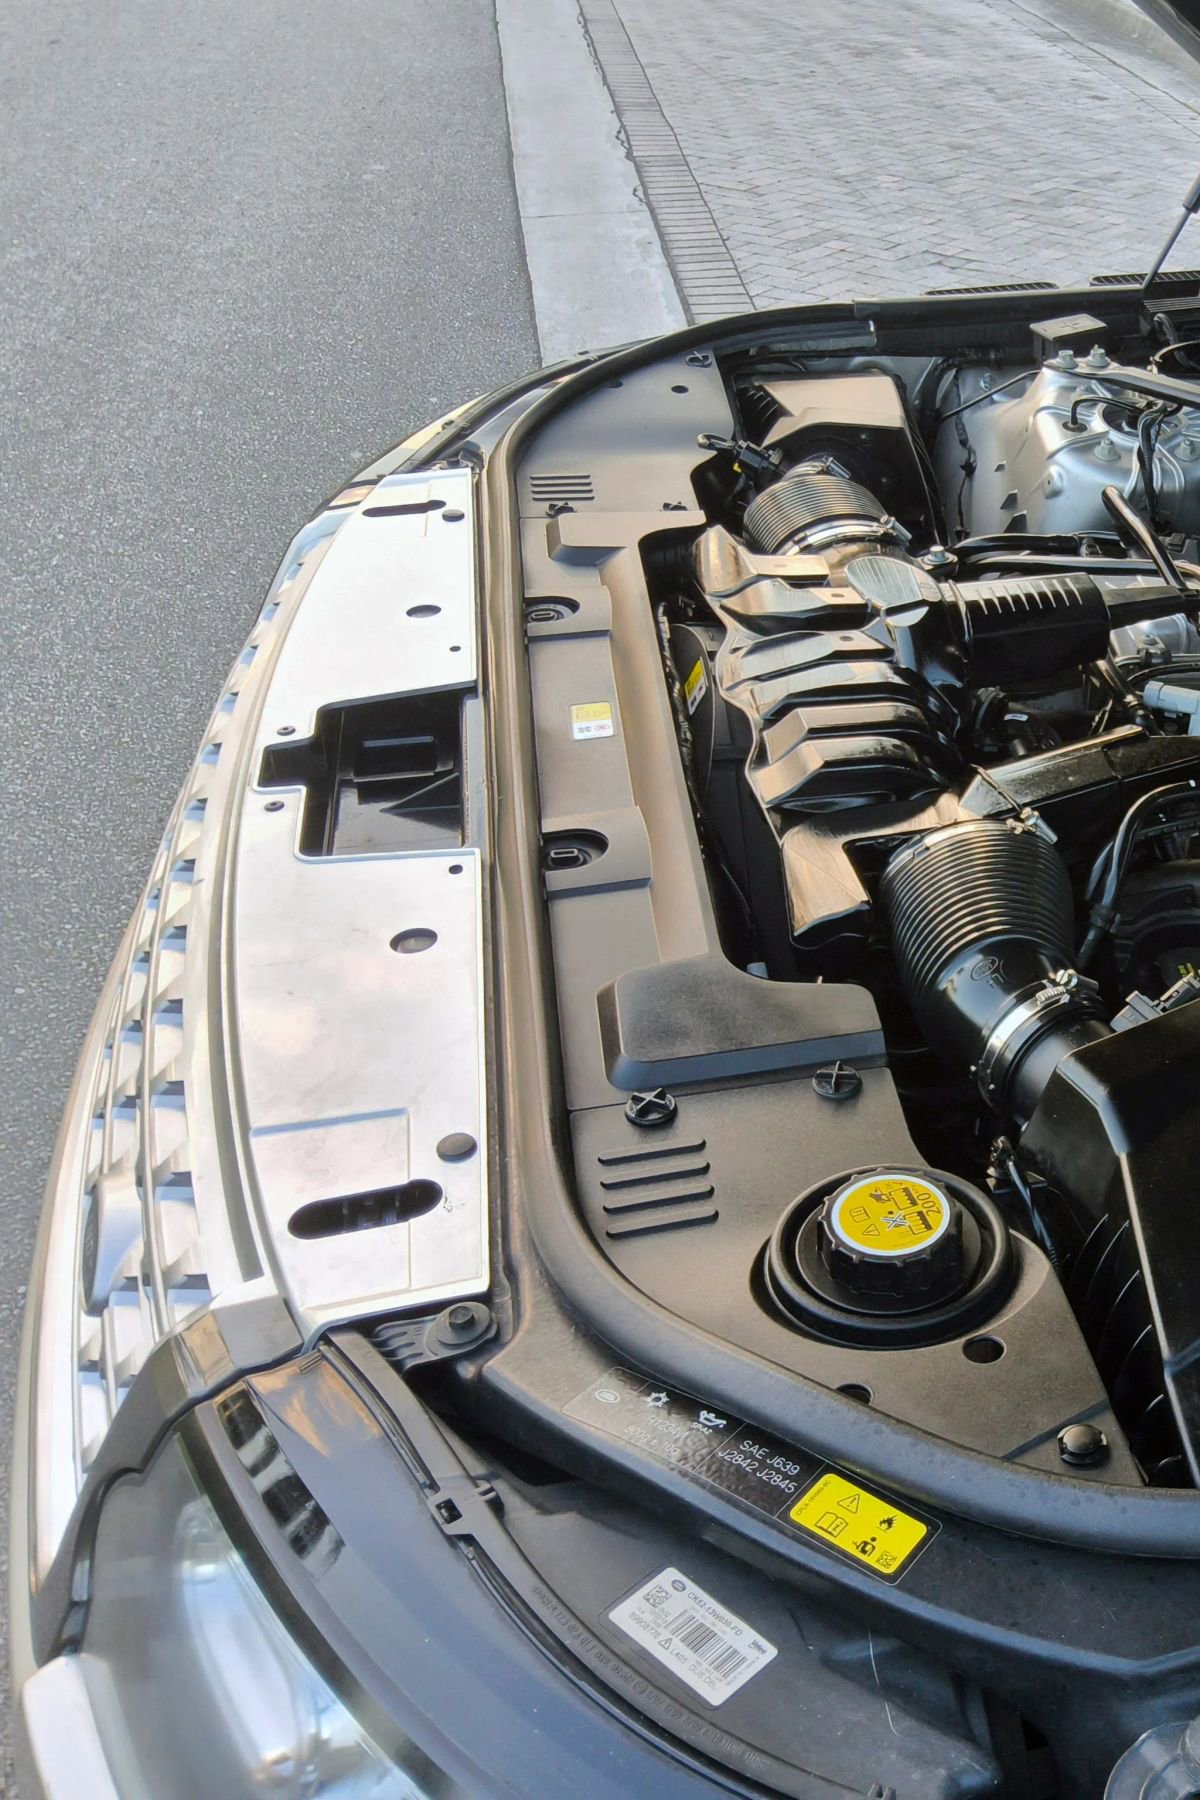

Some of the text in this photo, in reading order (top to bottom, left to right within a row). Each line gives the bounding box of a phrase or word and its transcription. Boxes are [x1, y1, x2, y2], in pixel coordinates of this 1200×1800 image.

[718, 1448, 798, 1493] J2842 J2845
[739, 1440, 800, 1475] SAE J639
